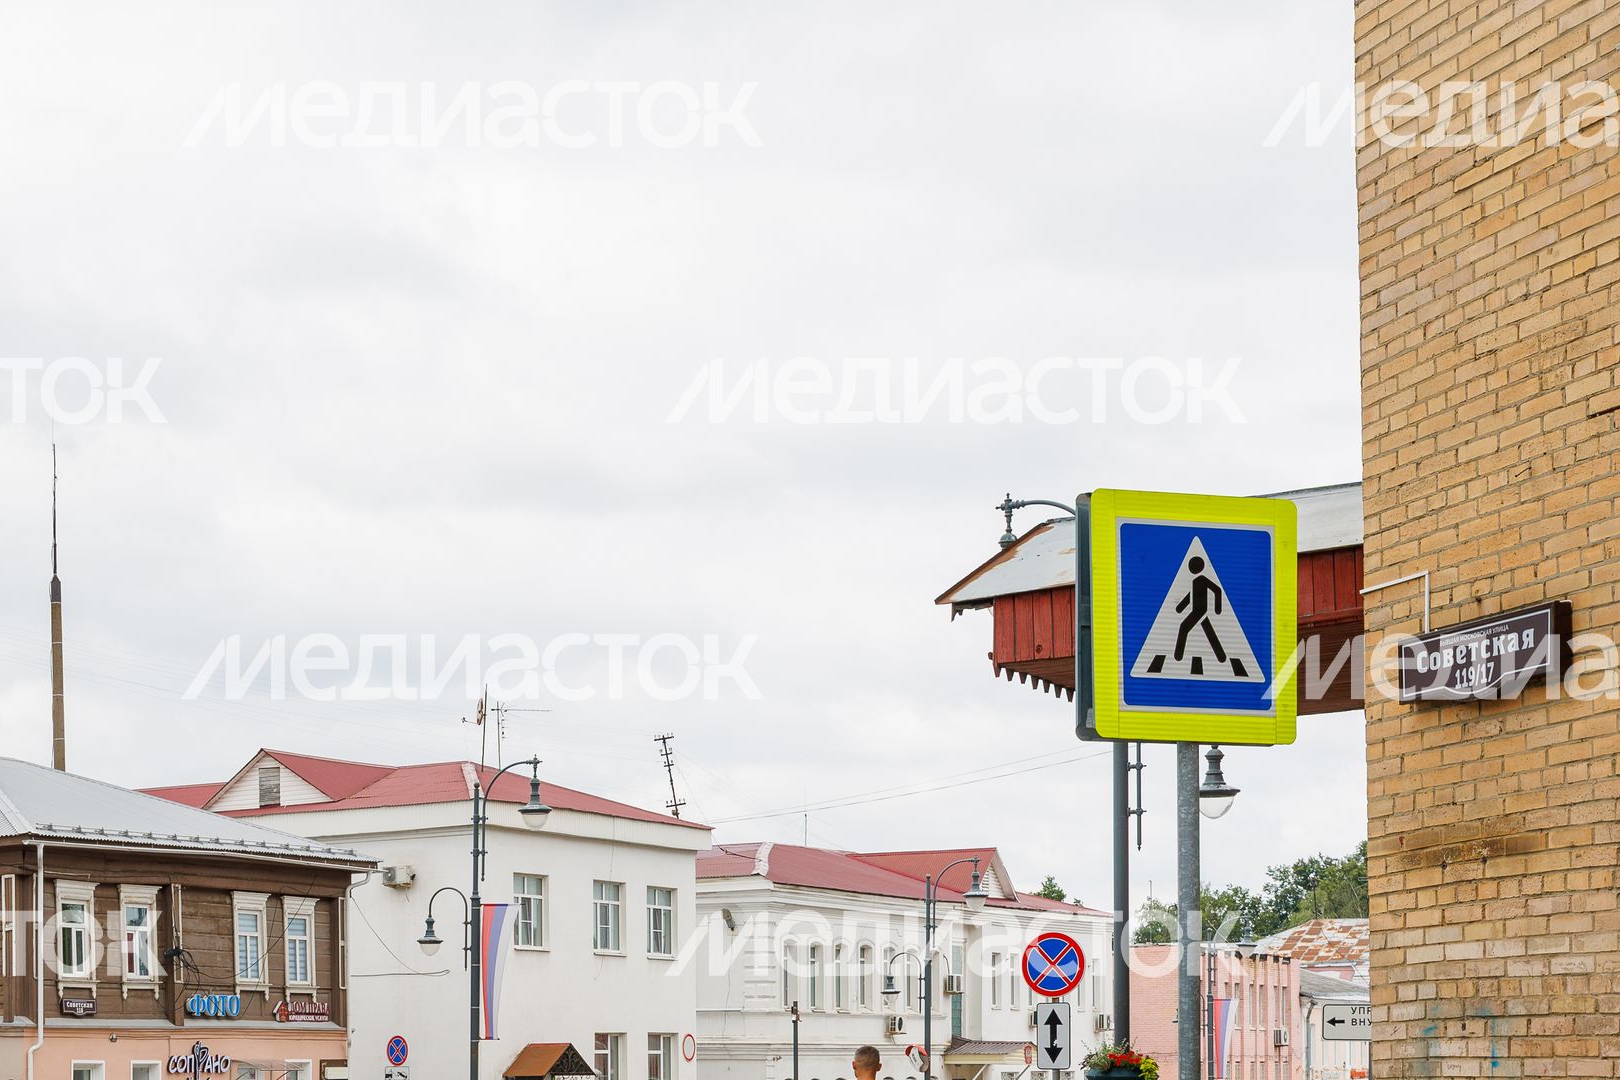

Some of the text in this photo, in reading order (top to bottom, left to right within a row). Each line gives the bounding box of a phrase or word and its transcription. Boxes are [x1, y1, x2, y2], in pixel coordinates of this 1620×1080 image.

[1492, 624, 1509, 635] УЛИЦА
[1416, 628, 1535, 674] Советская
[1455, 661, 1495, 690] 119/17
[66, 1001, 94, 1009] Советская
[188, 993, 241, 1017] ФОТО
[168, 1041, 231, 1075] СОПРАНО
